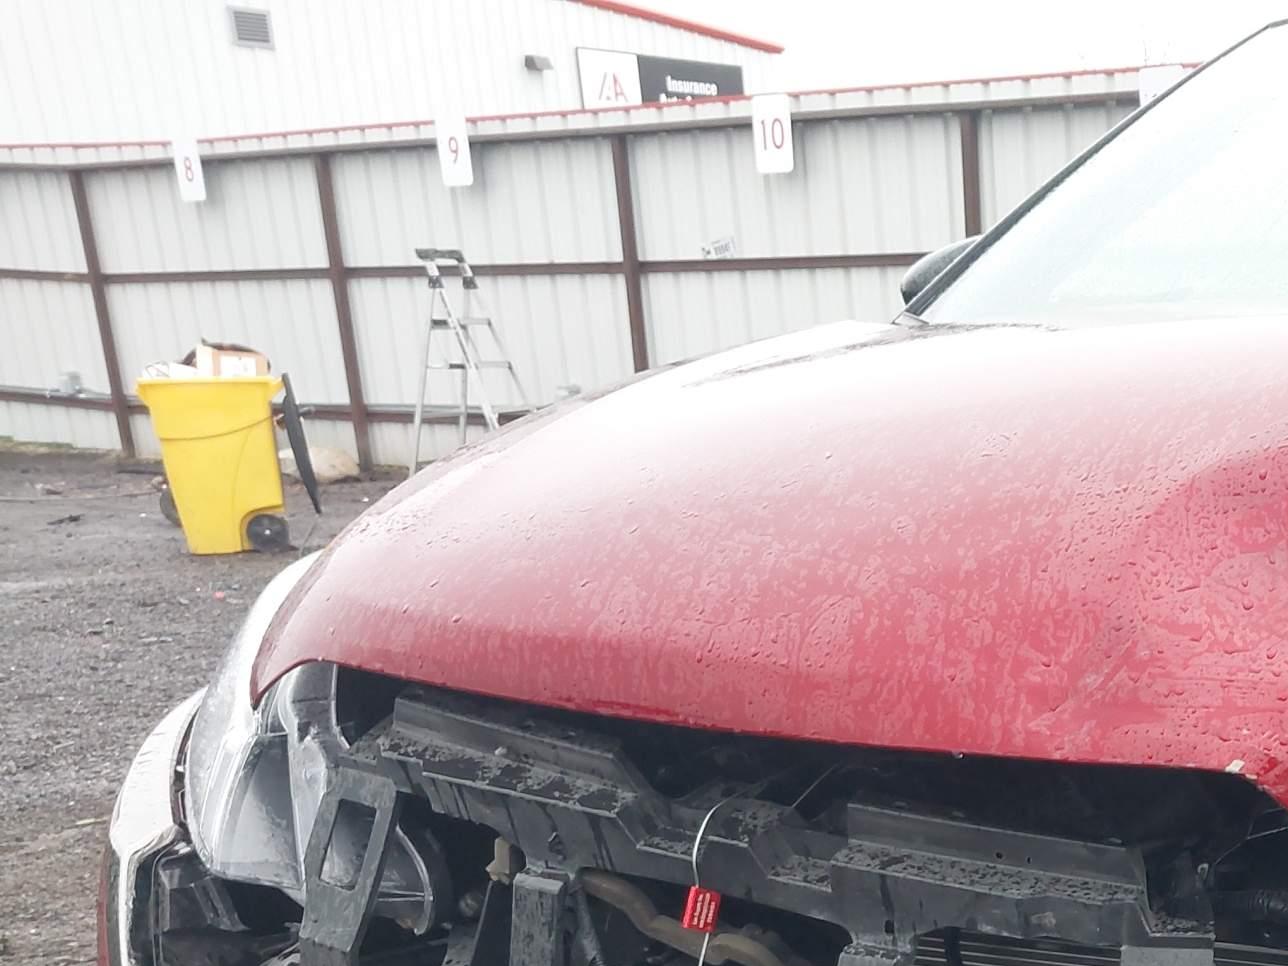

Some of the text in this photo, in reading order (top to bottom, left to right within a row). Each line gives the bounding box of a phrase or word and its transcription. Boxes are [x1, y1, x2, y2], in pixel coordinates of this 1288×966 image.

[665, 75, 719, 97] Insurance
[761, 117, 785, 151] 10
[448, 136, 459, 165] 9
[183, 155, 194, 182] 8
